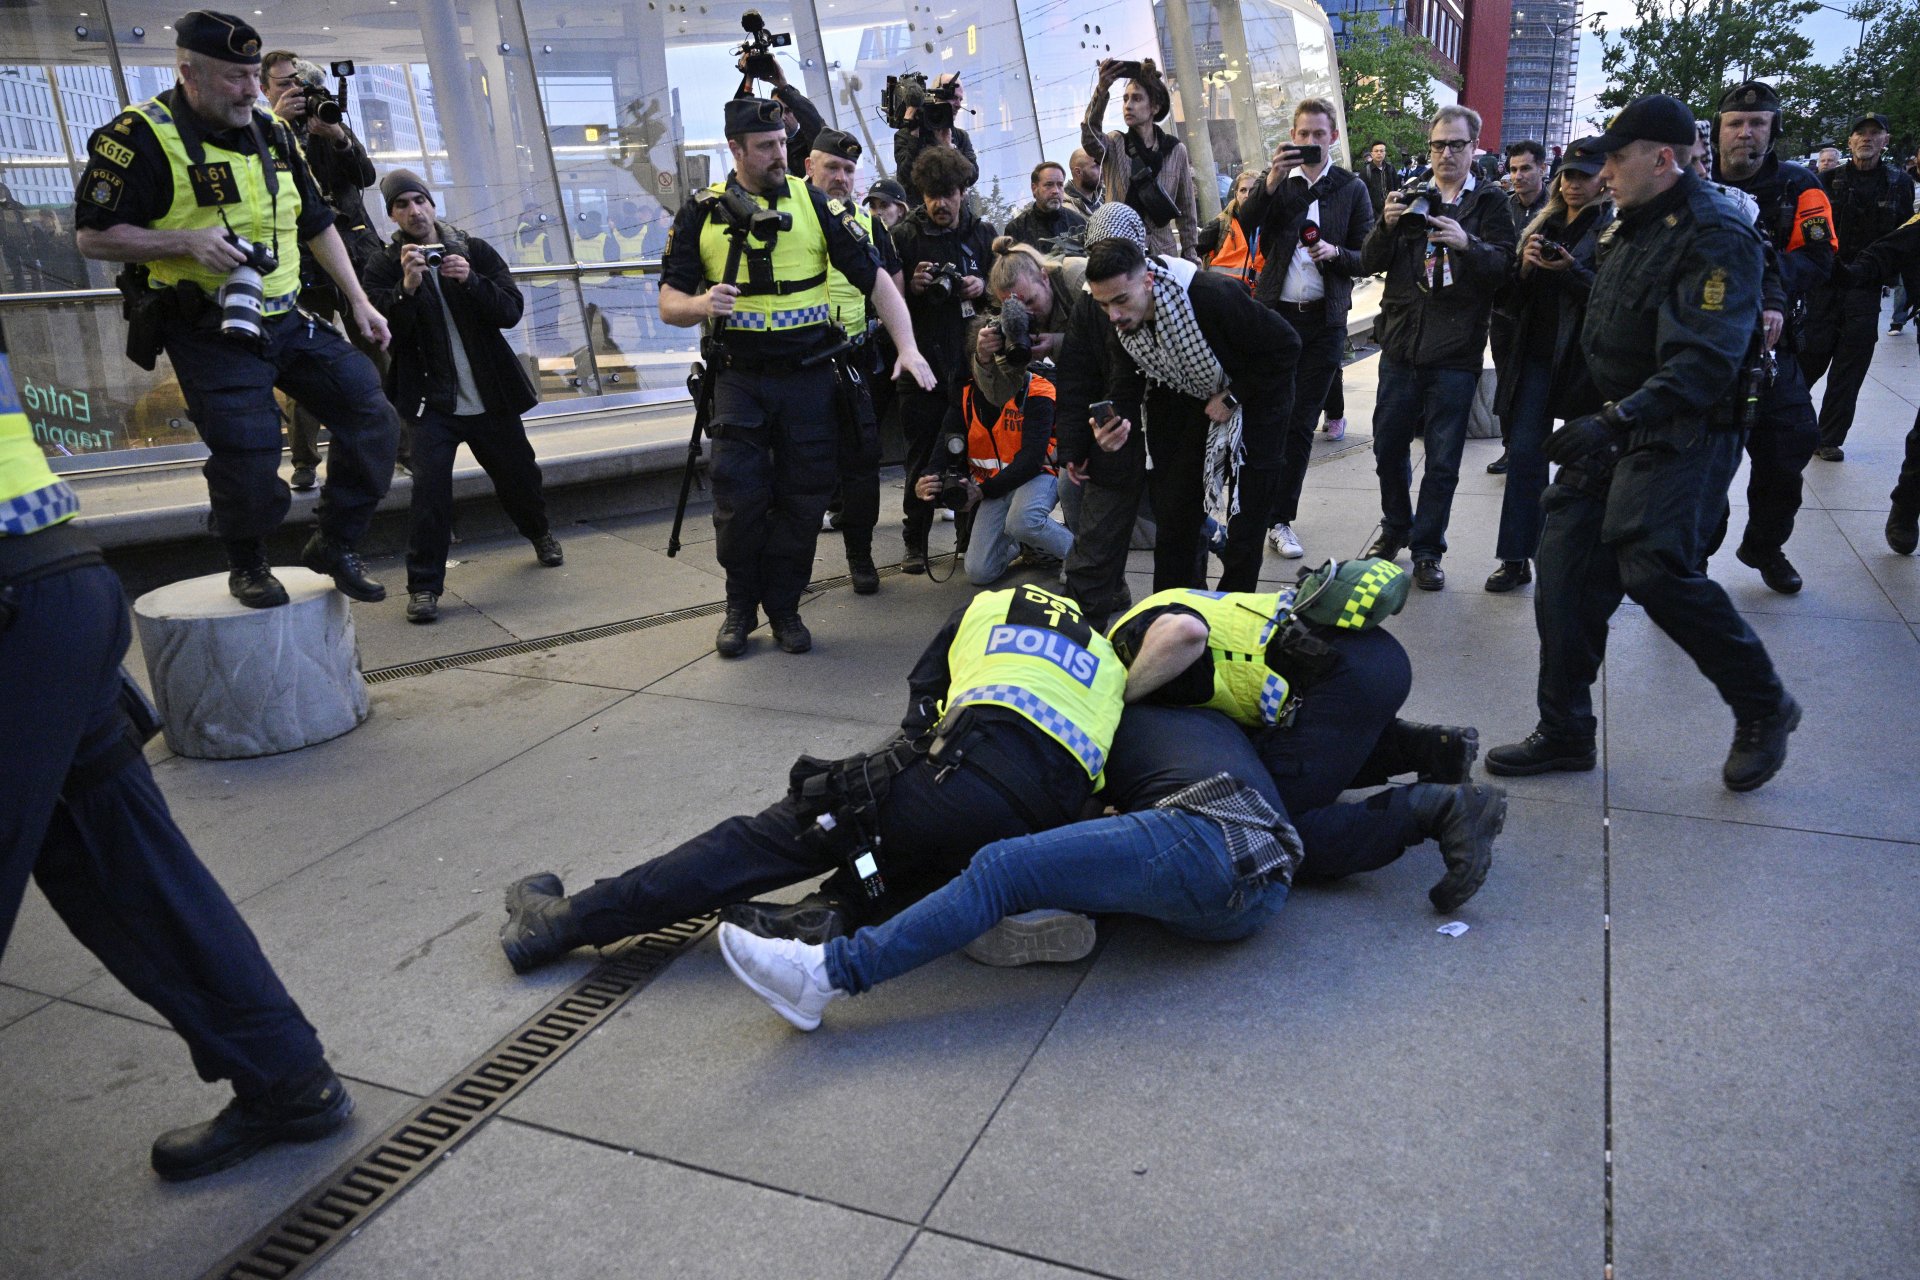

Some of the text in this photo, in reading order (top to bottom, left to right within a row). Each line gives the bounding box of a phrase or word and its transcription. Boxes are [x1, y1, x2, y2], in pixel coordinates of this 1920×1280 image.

[97, 138, 131, 165] K615
[93, 170, 122, 187] POLIS
[194, 166, 228, 183] K61
[210, 183, 225, 201] 5
[1803, 218, 1825, 228] POLIS
[1004, 419, 1023, 431] FOT
[1024, 590, 1080, 624] D61
[1043, 609, 1061, 628] 1
[988, 627, 1095, 680] POLIS
